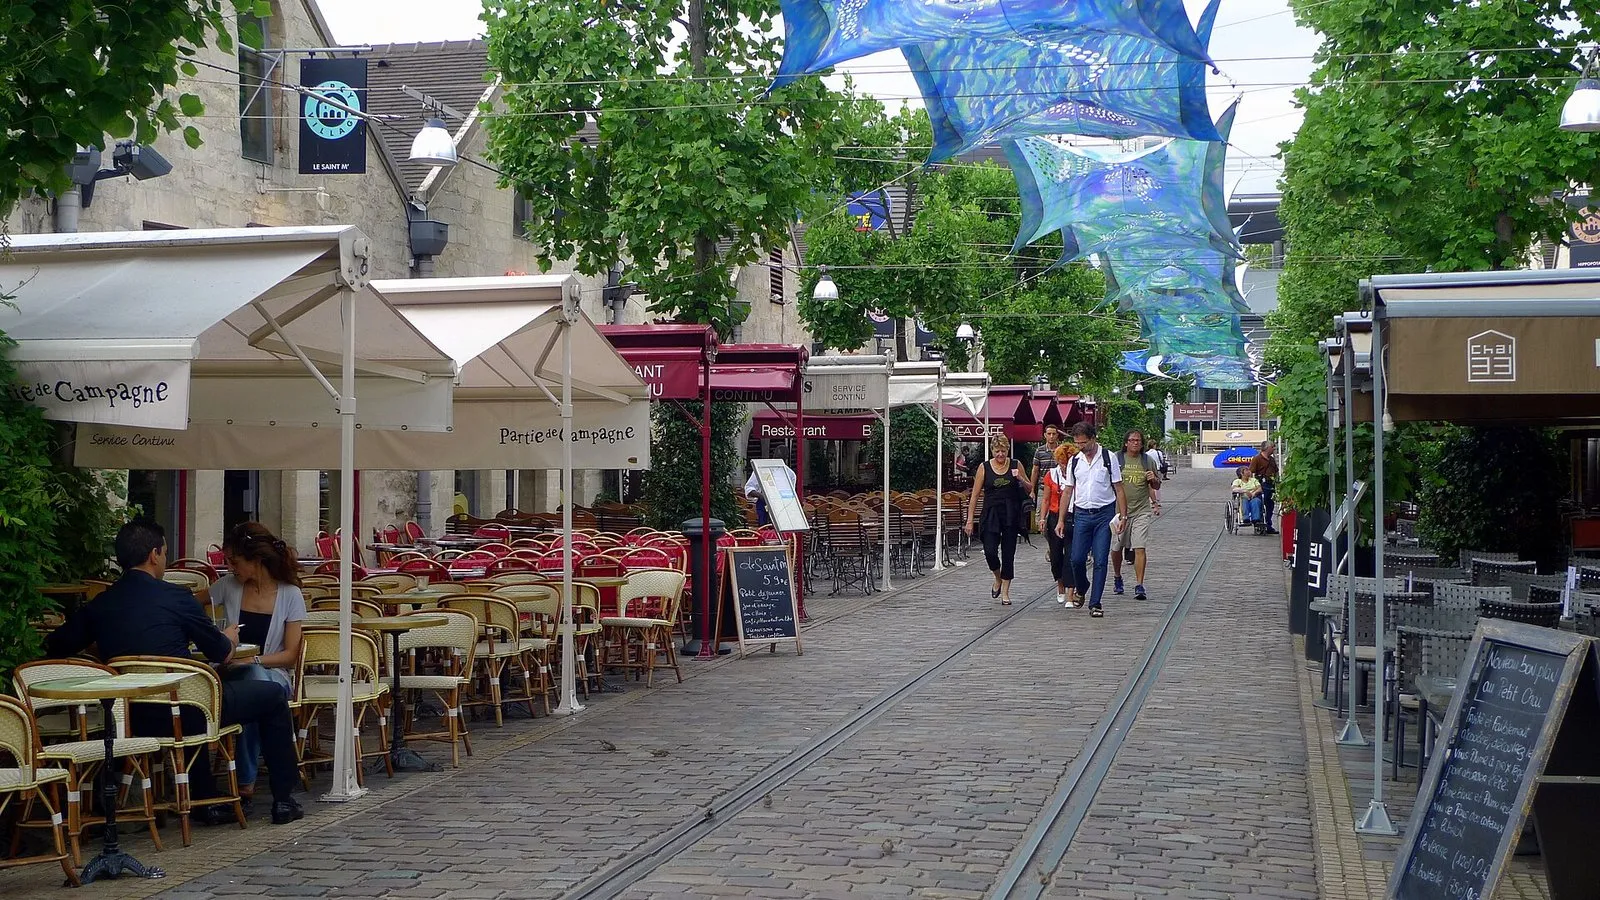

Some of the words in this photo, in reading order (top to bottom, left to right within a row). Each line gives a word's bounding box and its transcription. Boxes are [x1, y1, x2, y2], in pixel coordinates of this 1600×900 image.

[308, 111, 354, 136] VILLAG
[634, 365, 665, 378] ANT
[1471, 357, 1512, 375] 33
[36, 383, 52, 396] de
[55, 381, 168, 408] Campagne
[833, 385, 866, 393] SERVICE
[500, 428, 545, 445] Partie
[546, 429, 558, 439] de
[761, 424, 827, 436] Restarant
[90, 433, 128, 446] Service
[132, 433, 175, 446] Continu
[1482, 680, 1494, 693] au
[1499, 677, 1519, 701] Petit
